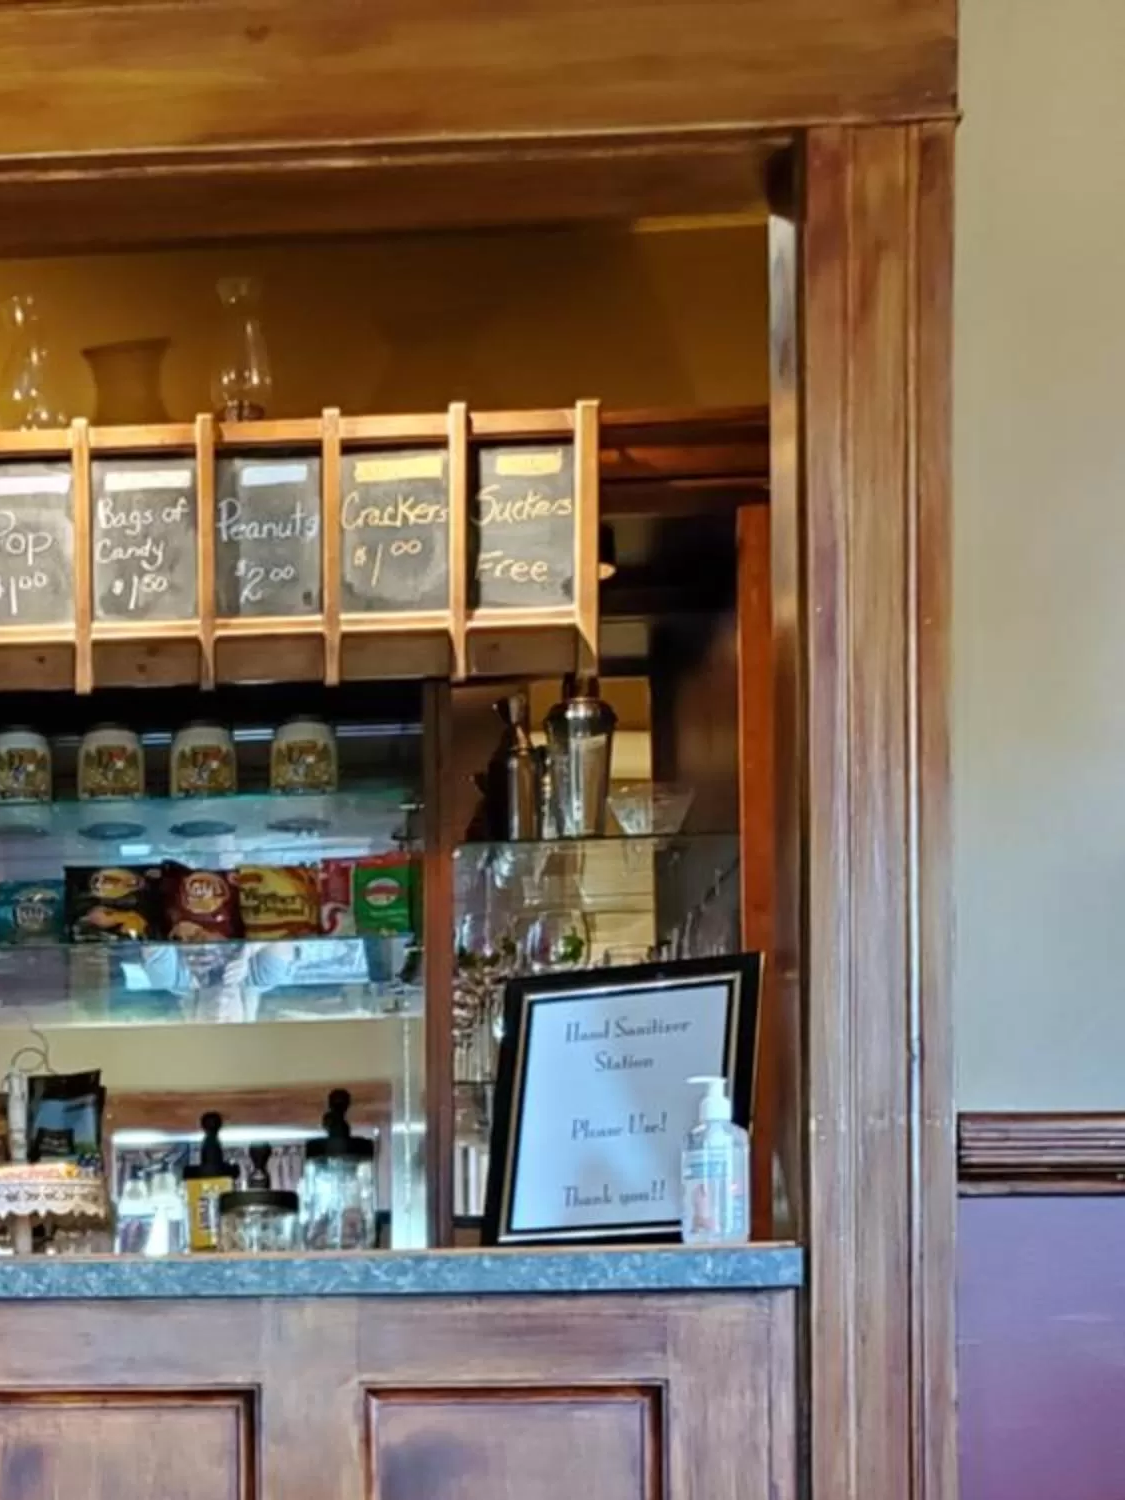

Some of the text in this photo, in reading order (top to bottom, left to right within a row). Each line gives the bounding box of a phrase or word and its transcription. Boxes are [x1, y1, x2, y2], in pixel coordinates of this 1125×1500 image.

[98, 496, 190, 535] Bags of
[216, 498, 320, 542] Peanuts
[340, 493, 450, 530] Crackers
[477, 485, 573, 527] Suckers
[95, 540, 165, 571] Candy
[477, 550, 549, 584] Free
[565, 1016, 692, 1044] Hand Sanitizer
[594, 1051, 654, 1072] Station
[571, 1112, 667, 1141] Please Use!
[563, 1184, 613, 1208] Thank
